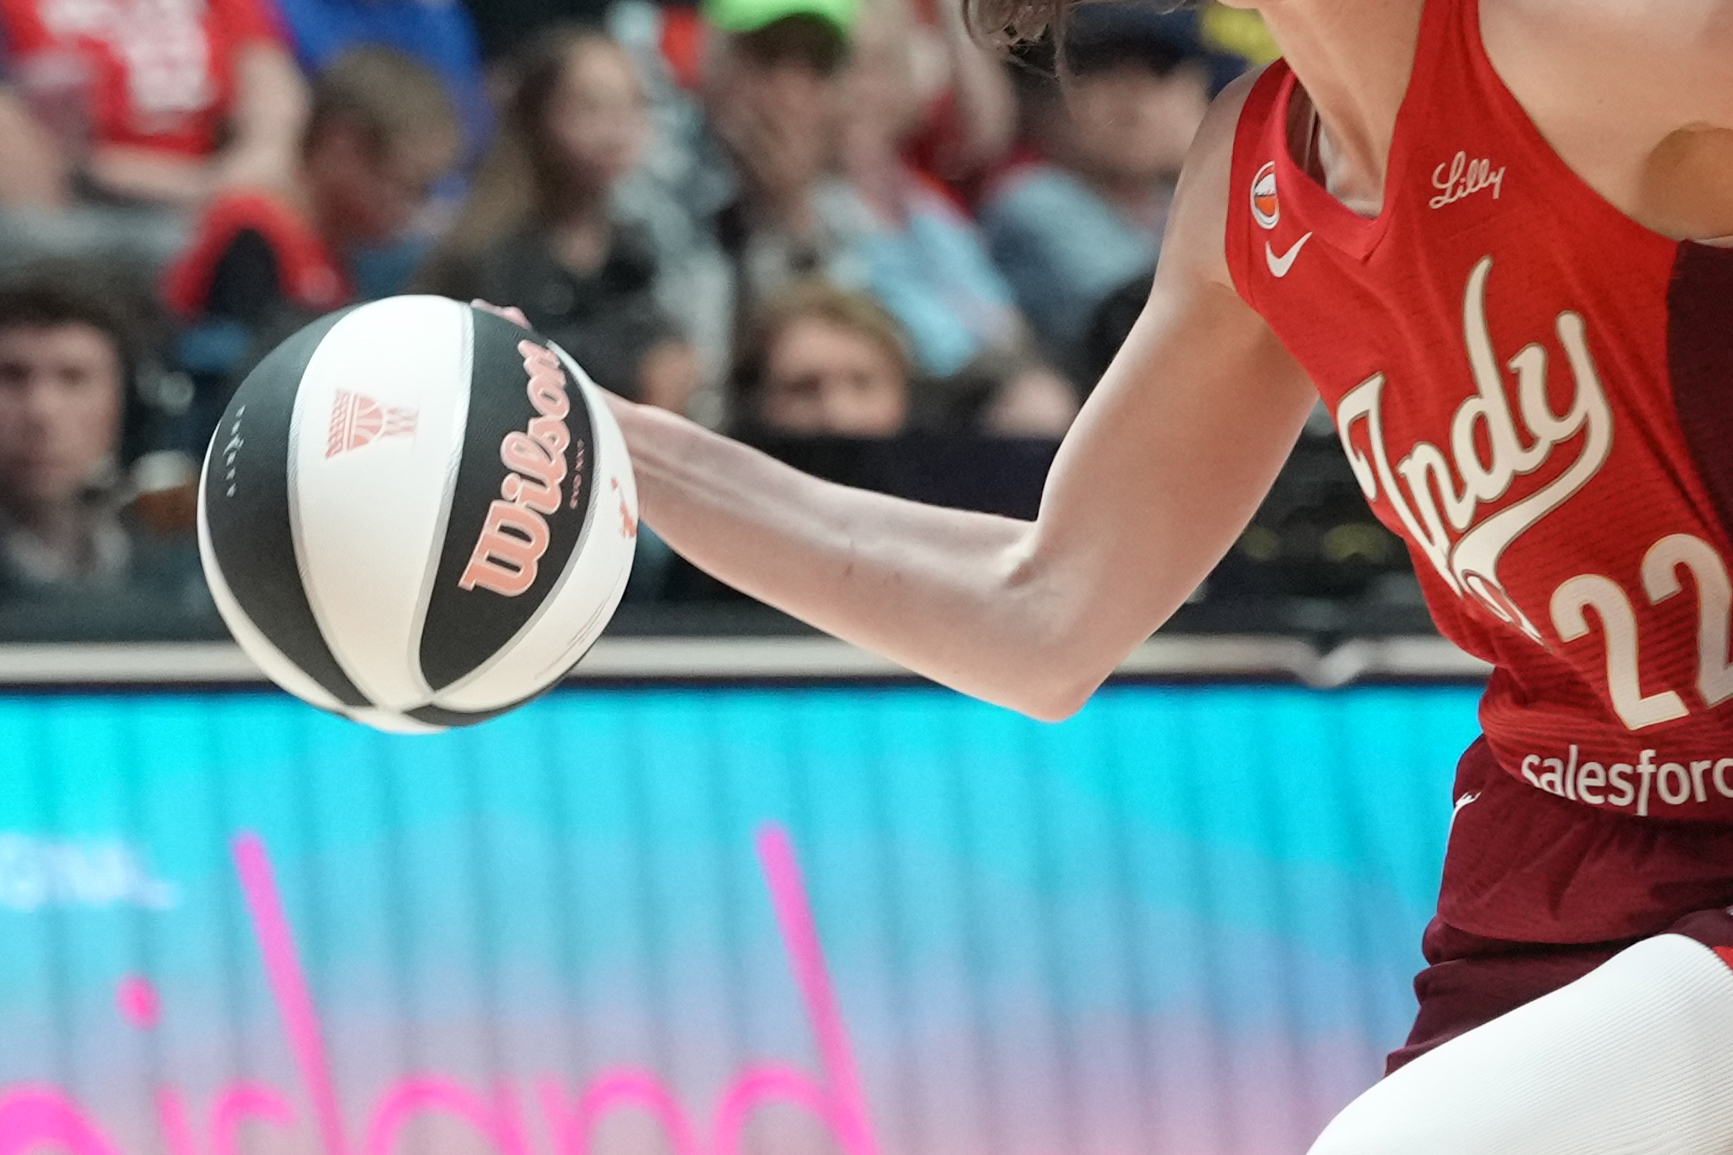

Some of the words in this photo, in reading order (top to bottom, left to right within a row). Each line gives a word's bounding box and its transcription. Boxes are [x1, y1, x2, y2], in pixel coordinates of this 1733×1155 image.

[1428, 150, 1506, 210] Lilly
[457, 339, 572, 599] Wilson
[1336, 254, 1615, 652] Indy
